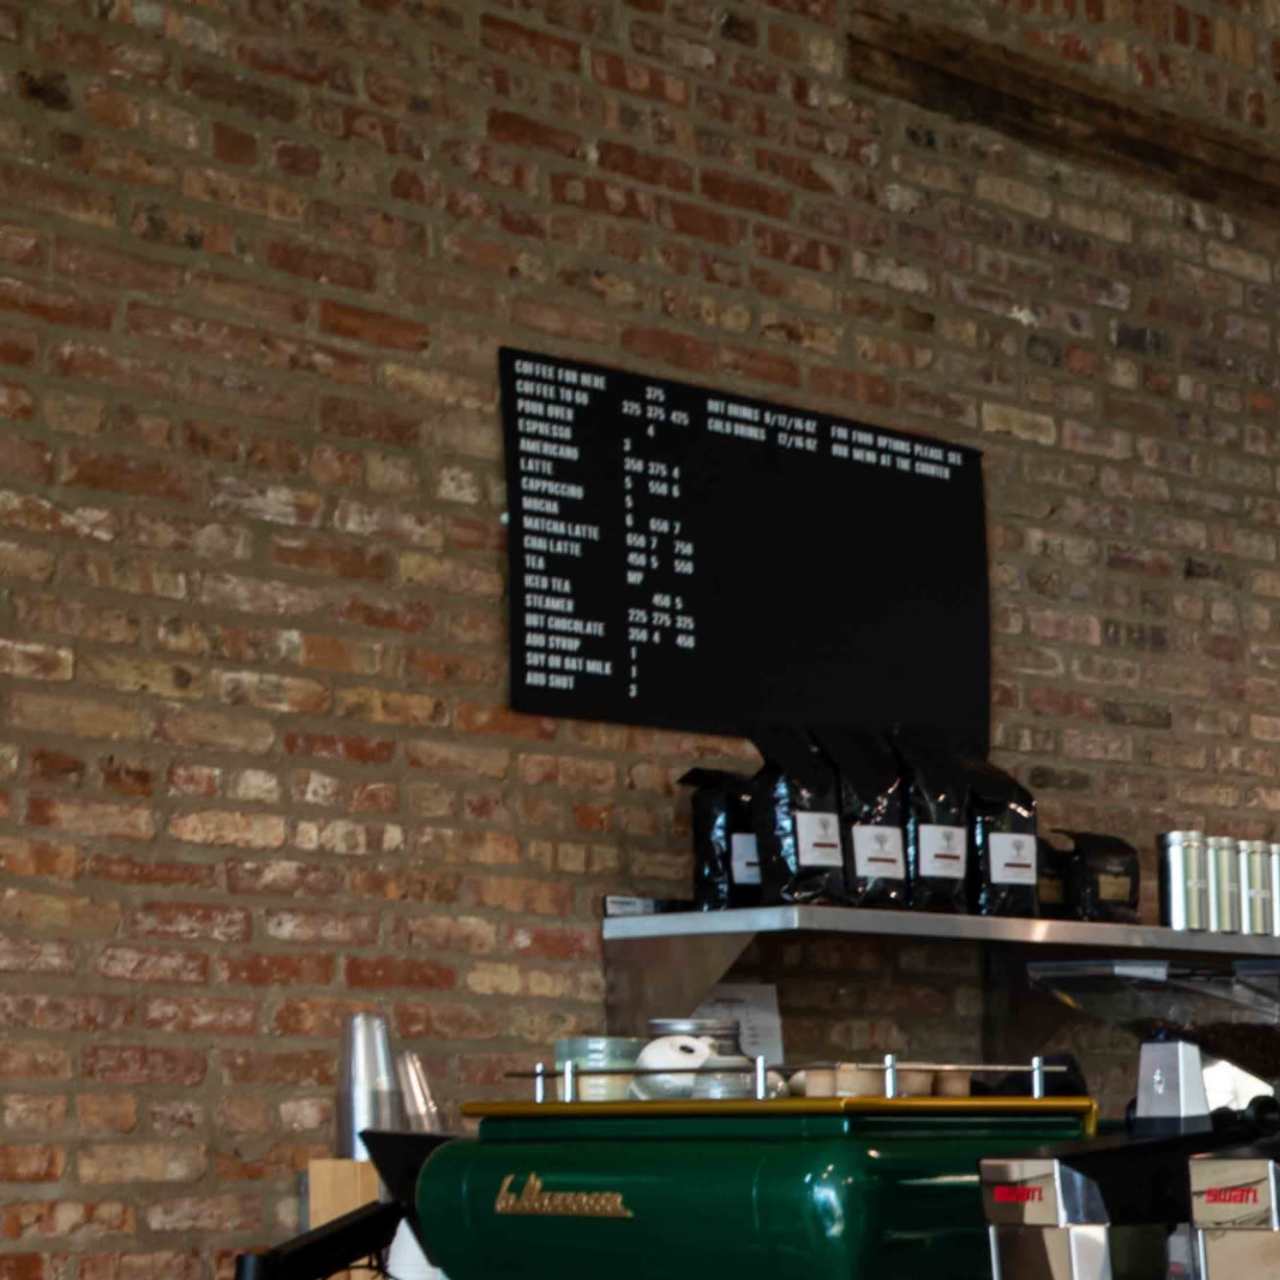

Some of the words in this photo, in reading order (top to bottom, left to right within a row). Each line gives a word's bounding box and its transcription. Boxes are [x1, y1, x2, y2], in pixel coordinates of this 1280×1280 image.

[515, 360, 554, 379] COFFEE
[558, 368, 578, 384] FOR
[581, 372, 606, 390] HERE
[516, 379, 556, 398] COFFEE
[560, 387, 572, 402] TO
[575, 390, 589, 406] GO
[517, 399, 544, 416] POUR
[547, 405, 574, 422] OVER
[518, 418, 572, 440] ESPRESSO
[520, 438, 580, 461] AMERICANO
[672, 466, 680, 479] 4
[914, 443, 944, 462] PLEASE
[520, 456, 554, 475] LATTE
[880, 454, 892, 466] AT
[896, 457, 911, 471] THE
[915, 461, 950, 480] COUNTER
[521, 476, 584, 500] CAPPUCCINO
[522, 496, 560, 514] MOCHA
[673, 521, 681, 536] 7
[523, 515, 566, 534] MATCHA
[568, 522, 600, 542] LATTE
[650, 536, 658, 550] 7
[524, 534, 548, 551] CHAI
[550, 539, 582, 557] LATTE
[650, 555, 658, 570] 5
[525, 554, 545, 570] TEA
[524, 574, 548, 590] ICED
[551, 578, 572, 594] TEA
[675, 596, 682, 610] 5
[525, 593, 574, 613] STEAMER
[525, 612, 545, 628] HOT
[548, 616, 605, 637] CHOCOLATE
[652, 631, 660, 644] 4
[526, 632, 546, 648] ADD
[549, 636, 582, 652] SYRUP
[526, 652, 546, 666] SOY
[548, 654, 562, 669] OR
[564, 656, 583, 672] OAT
[586, 660, 612, 676] MILK
[526, 672, 546, 686] ADD
[548, 674, 575, 690] SHOT
